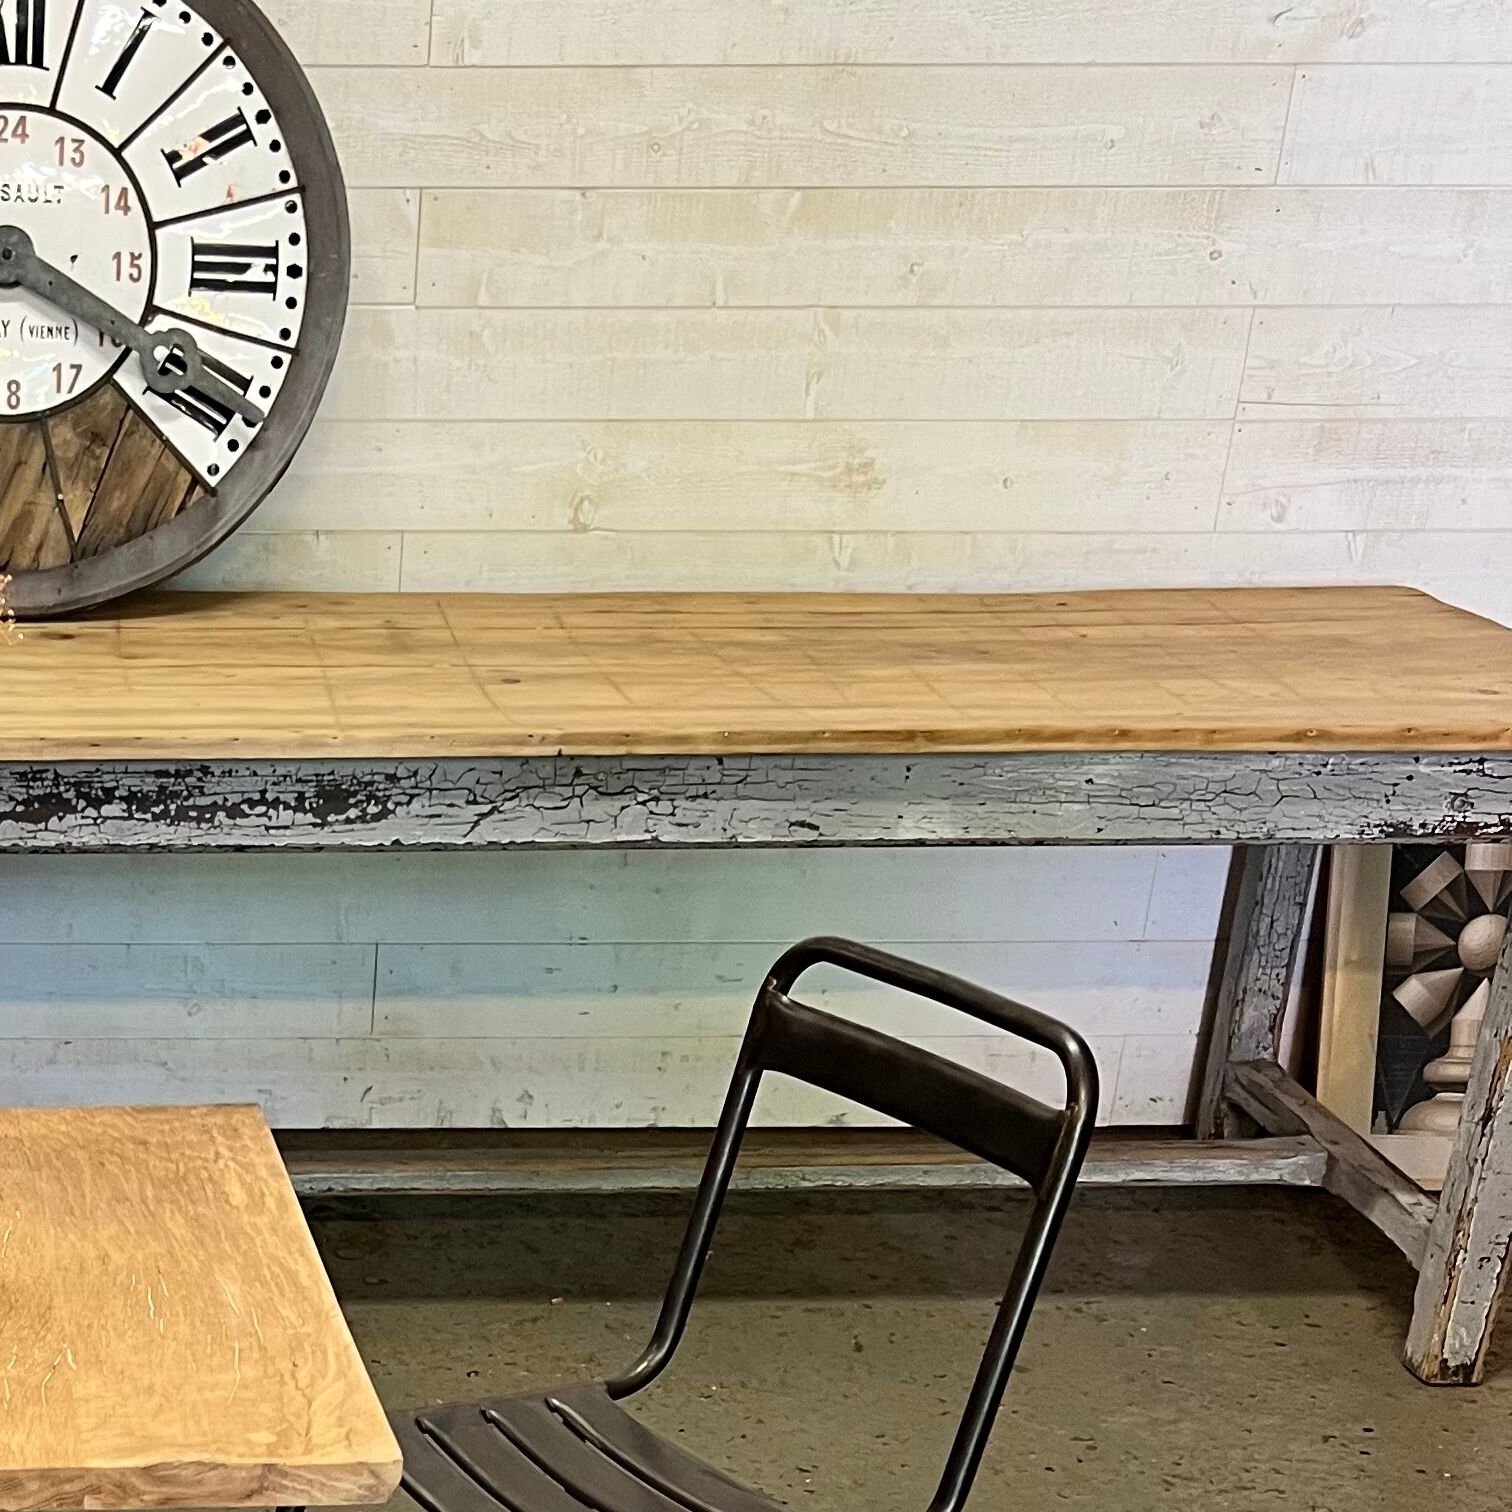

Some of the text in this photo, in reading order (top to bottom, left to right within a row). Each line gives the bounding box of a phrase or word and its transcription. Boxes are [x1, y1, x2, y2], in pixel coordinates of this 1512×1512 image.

[55, 136, 86, 168] 13
[161, 106, 257, 188] II
[100, 185, 131, 216] 14
[112, 252, 143, 283] 15
[189, 237, 279, 301] III
[52, 363, 83, 394] 17
